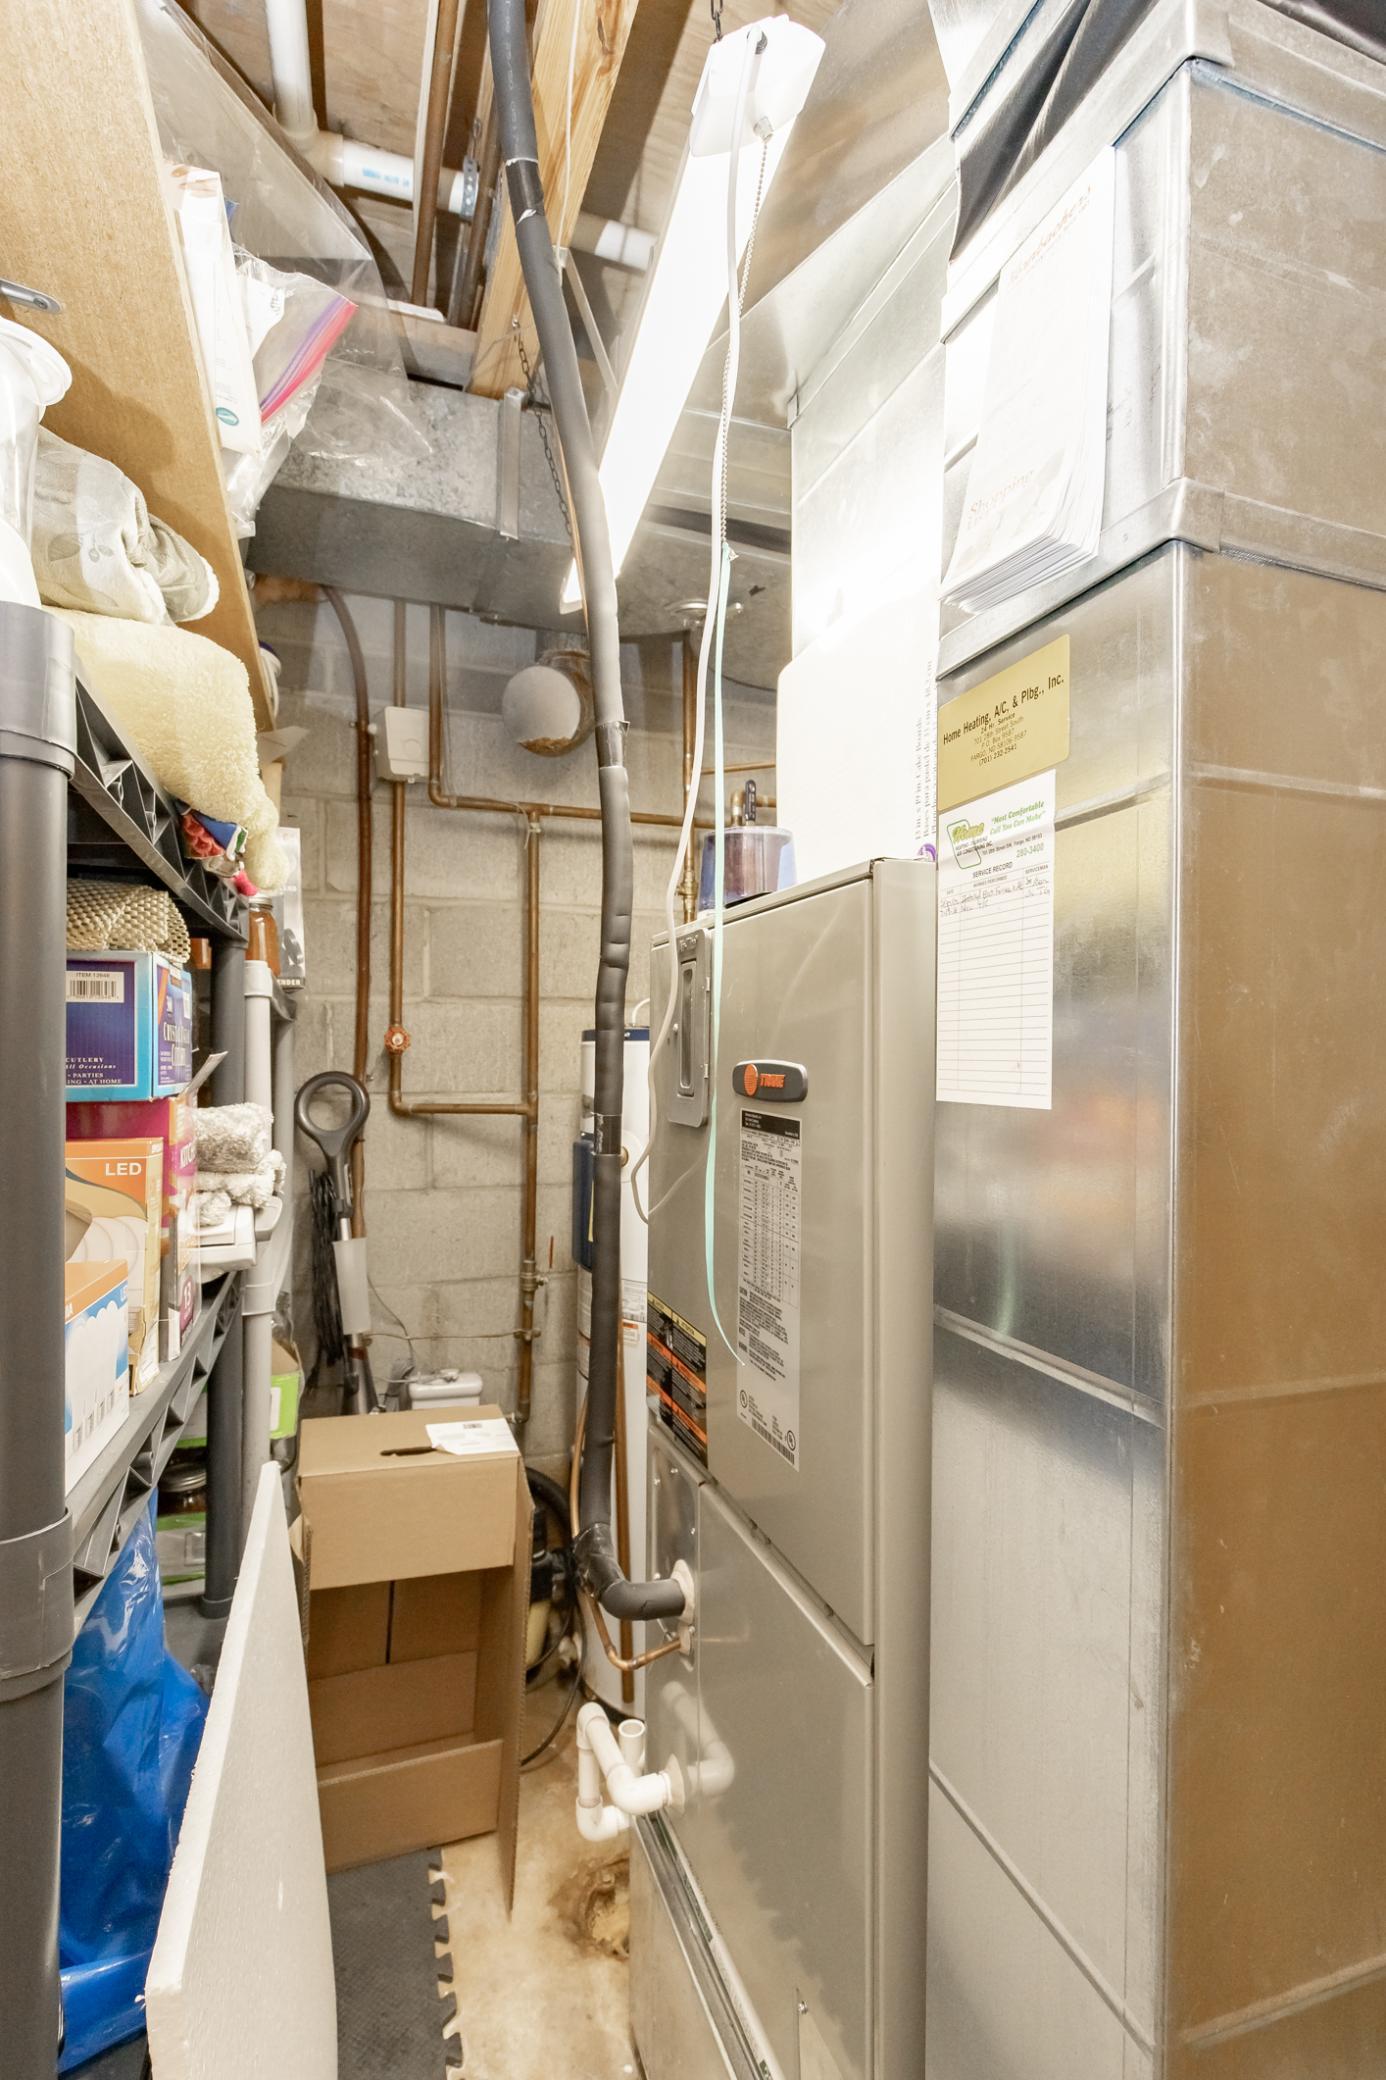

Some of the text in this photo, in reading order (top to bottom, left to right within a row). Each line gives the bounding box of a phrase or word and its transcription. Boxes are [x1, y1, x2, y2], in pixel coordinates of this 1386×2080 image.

[943, 728, 961, 745] Home
[1012, 695, 1018, 708] &
[1048, 674, 1064, 690] Inc.
[998, 712, 1016, 725] Service
[1008, 800, 1044, 819] Comfortable
[973, 861, 1013, 879] SERVICE RECORD
[105, 1163, 142, 1176] LED
